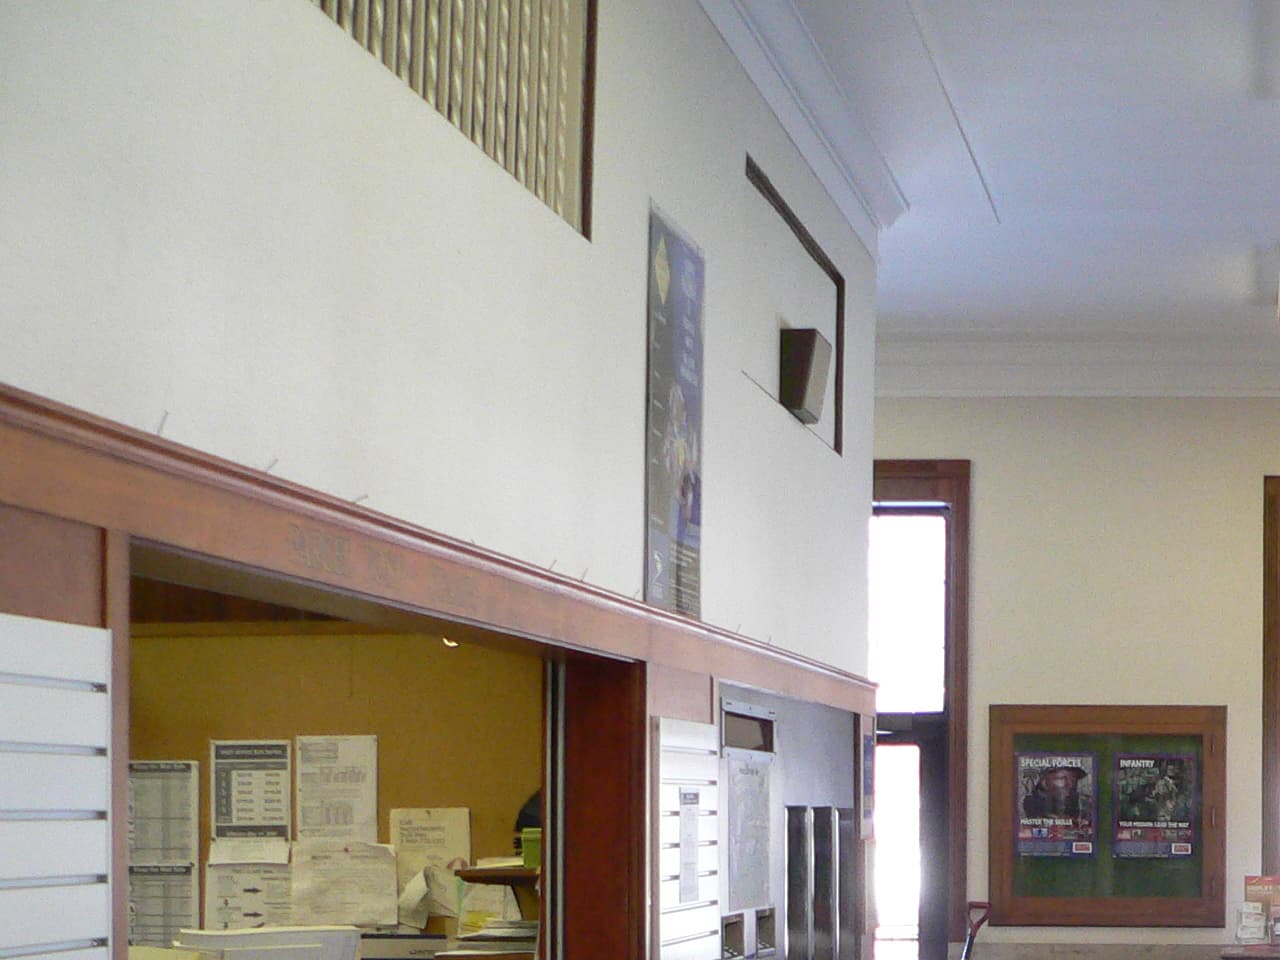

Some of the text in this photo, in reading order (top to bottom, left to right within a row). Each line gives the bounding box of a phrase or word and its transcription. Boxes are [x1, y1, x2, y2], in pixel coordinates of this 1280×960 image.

[1021, 757, 1082, 768] SPECIAL FORCES
[1120, 759, 1155, 768] INFANTRY
